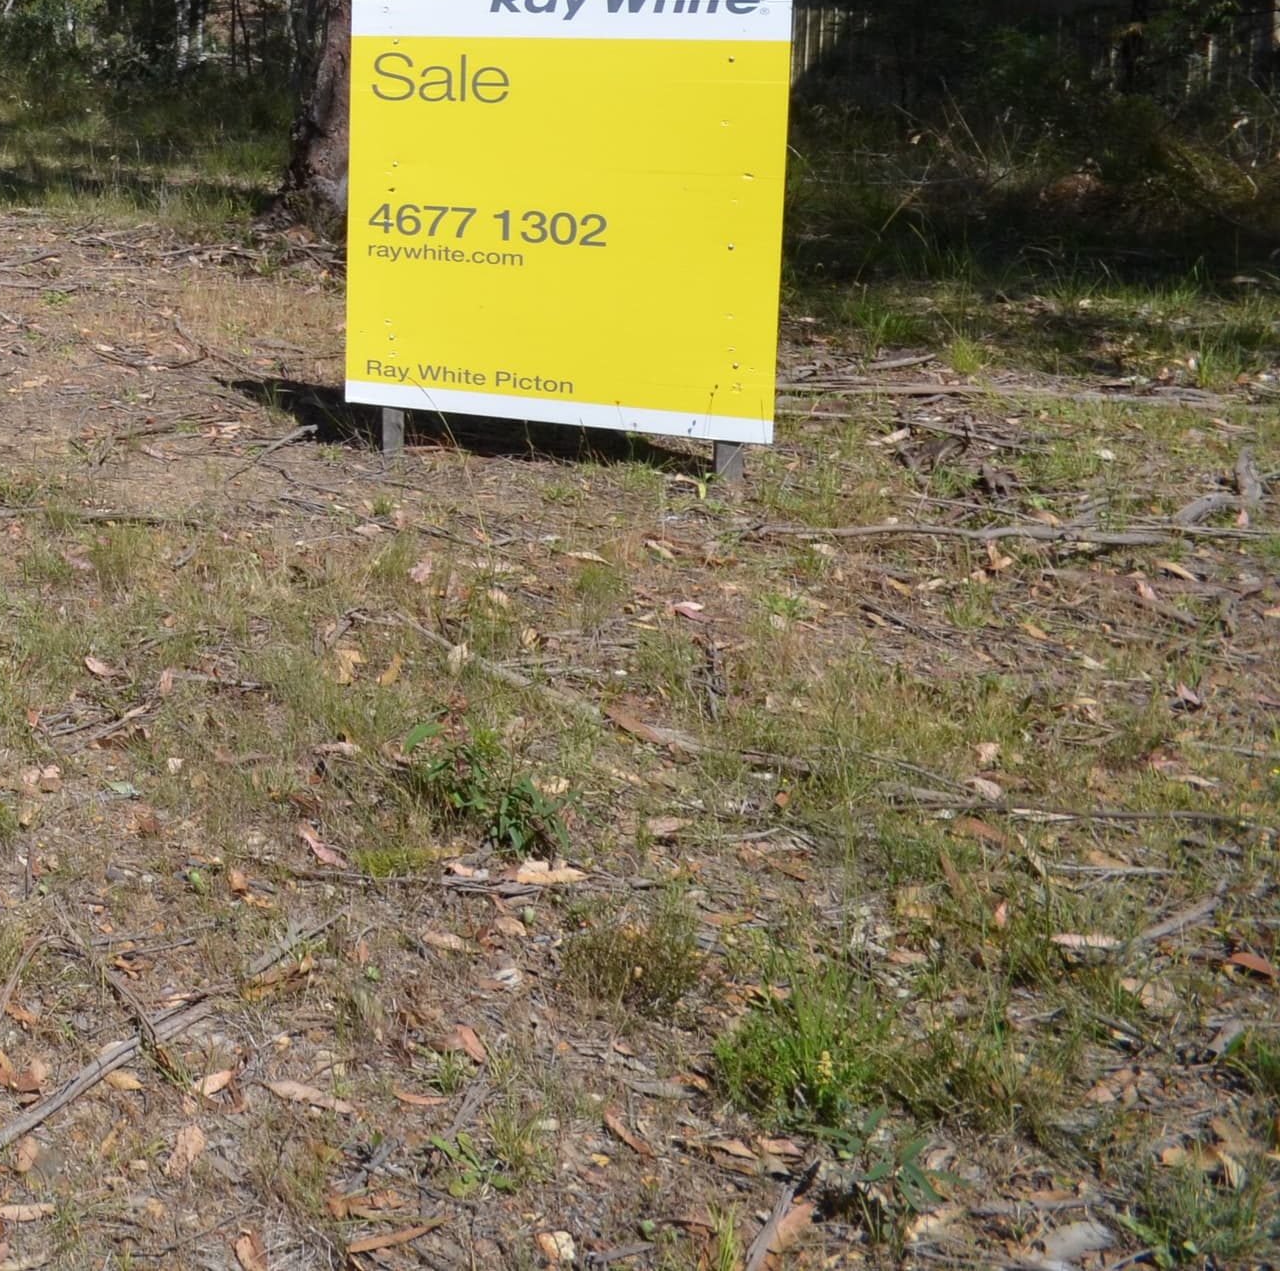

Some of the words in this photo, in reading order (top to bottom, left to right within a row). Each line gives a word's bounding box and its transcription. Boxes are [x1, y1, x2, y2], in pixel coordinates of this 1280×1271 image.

[371, 51, 510, 104] Sale
[368, 203, 477, 239] 4677
[493, 209, 608, 248] 1302
[367, 243, 524, 267] raywhite.com
[366, 359, 410, 382] Ray
[418, 364, 486, 386] White
[495, 370, 574, 394] Picton
